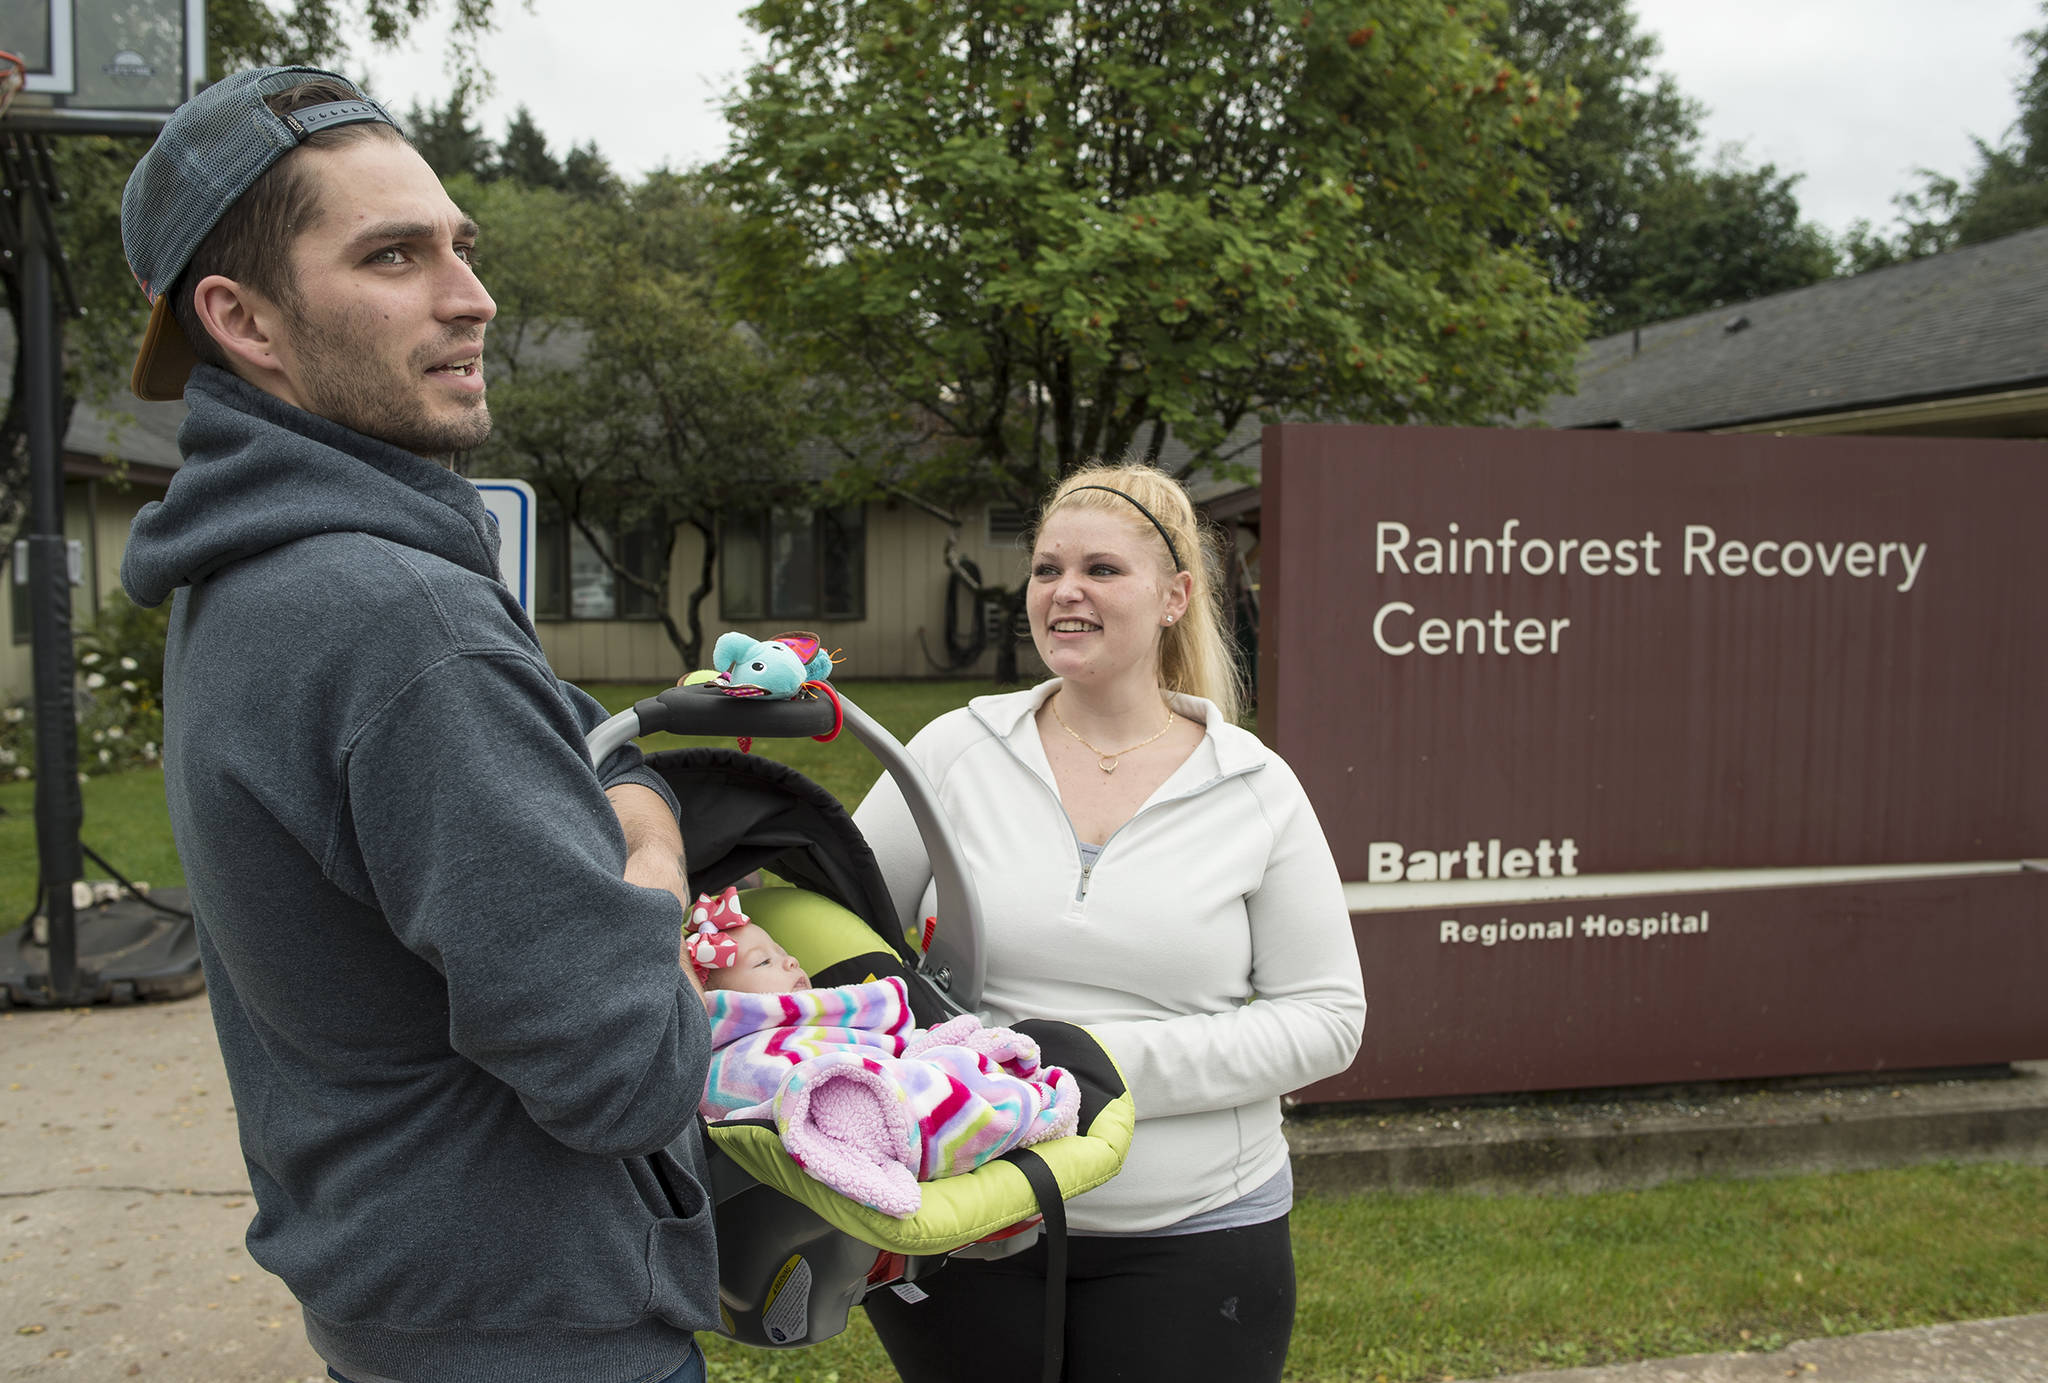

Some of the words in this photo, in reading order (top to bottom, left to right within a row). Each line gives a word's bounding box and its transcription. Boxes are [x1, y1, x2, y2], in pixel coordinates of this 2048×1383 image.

[1377, 519, 1662, 576] Rainforest
[1683, 525, 1927, 593] Recovery
[1372, 602, 1571, 656] Center
[1368, 839, 1579, 883] Bartlett
[1440, 915, 1574, 947] Regional
[1580, 910, 1709, 940] Hospital
